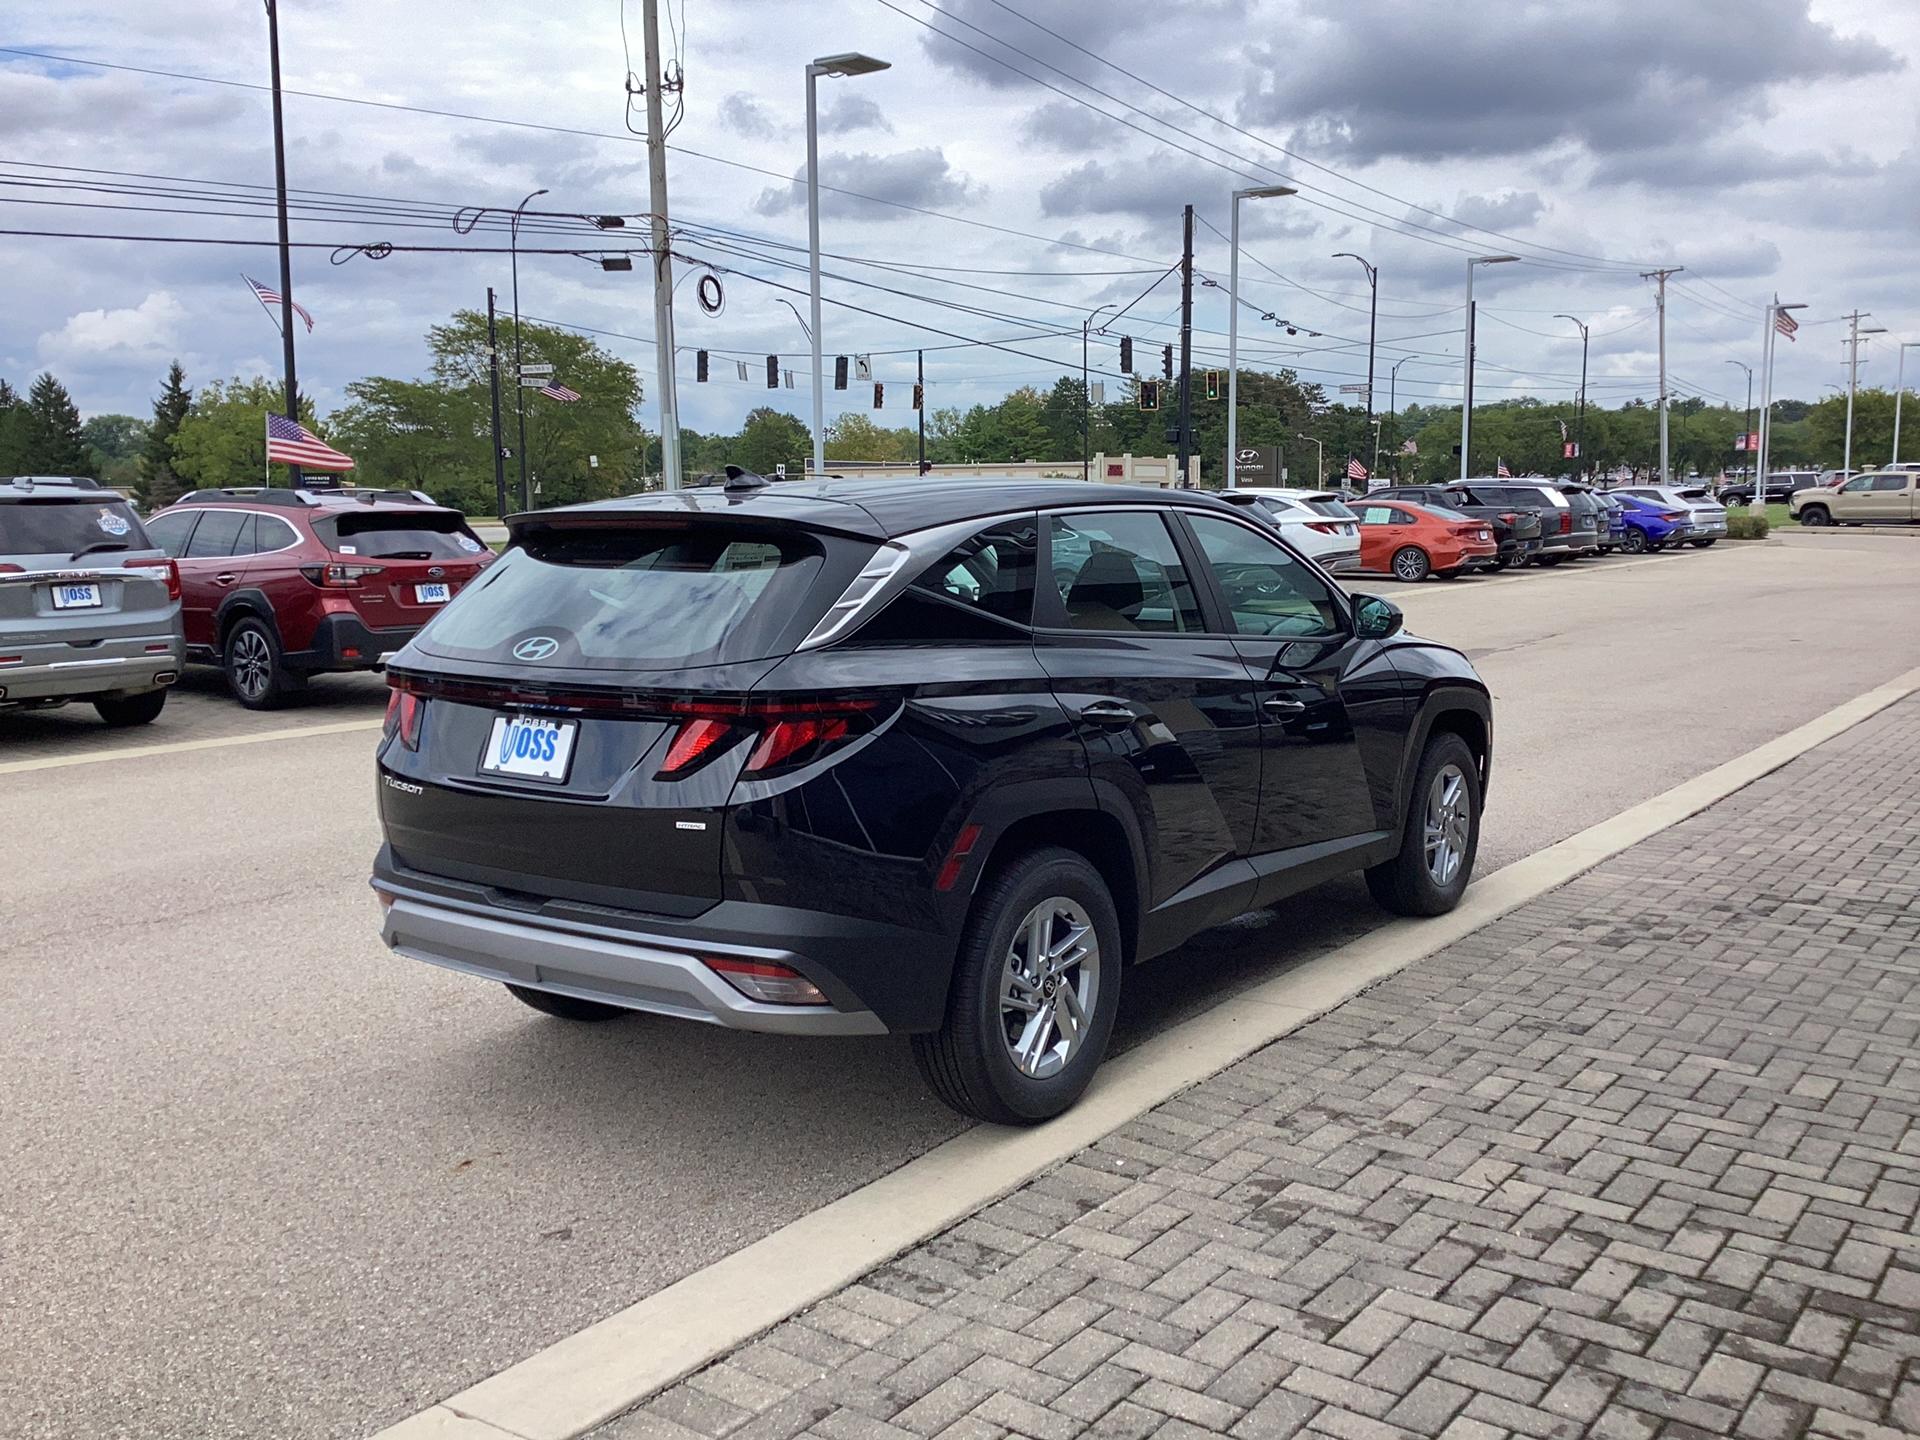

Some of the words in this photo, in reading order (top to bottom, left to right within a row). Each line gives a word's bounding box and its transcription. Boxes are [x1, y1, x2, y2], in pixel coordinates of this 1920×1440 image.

[60, 587, 92, 604] VOSS
[421, 586, 444, 600] VOSS
[500, 725, 559, 764] VOSS
